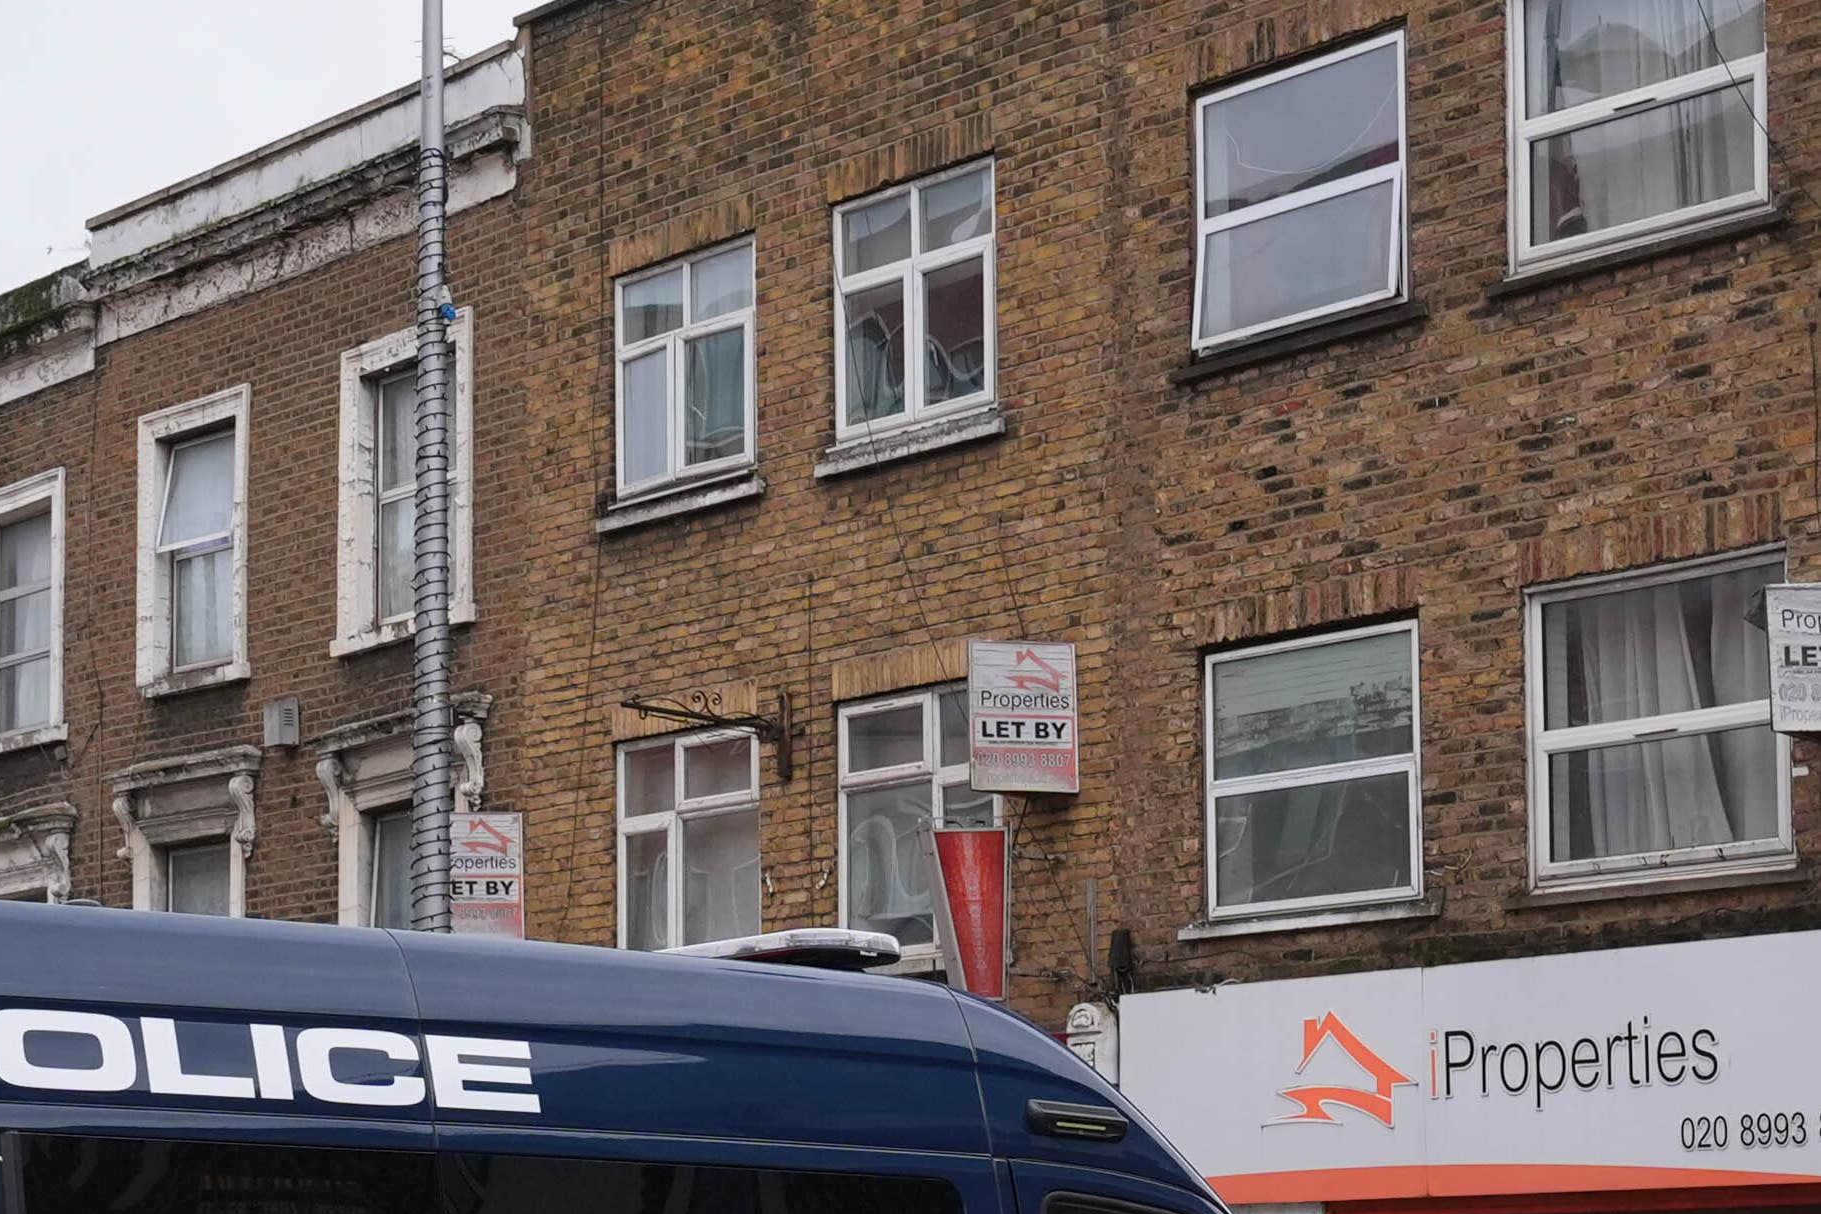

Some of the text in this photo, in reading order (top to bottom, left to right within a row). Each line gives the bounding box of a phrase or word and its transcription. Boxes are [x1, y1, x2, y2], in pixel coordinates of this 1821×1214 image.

[1784, 645, 1821, 667] LE
[981, 690, 1070, 712] Properties
[982, 721, 1067, 739] LET BY
[977, 752, 1071, 768] 020 8993 8807
[452, 880, 514, 896] ET BY
[1430, 1015, 1719, 1108] iProperties
[1681, 1111, 1807, 1150] 020 8993
